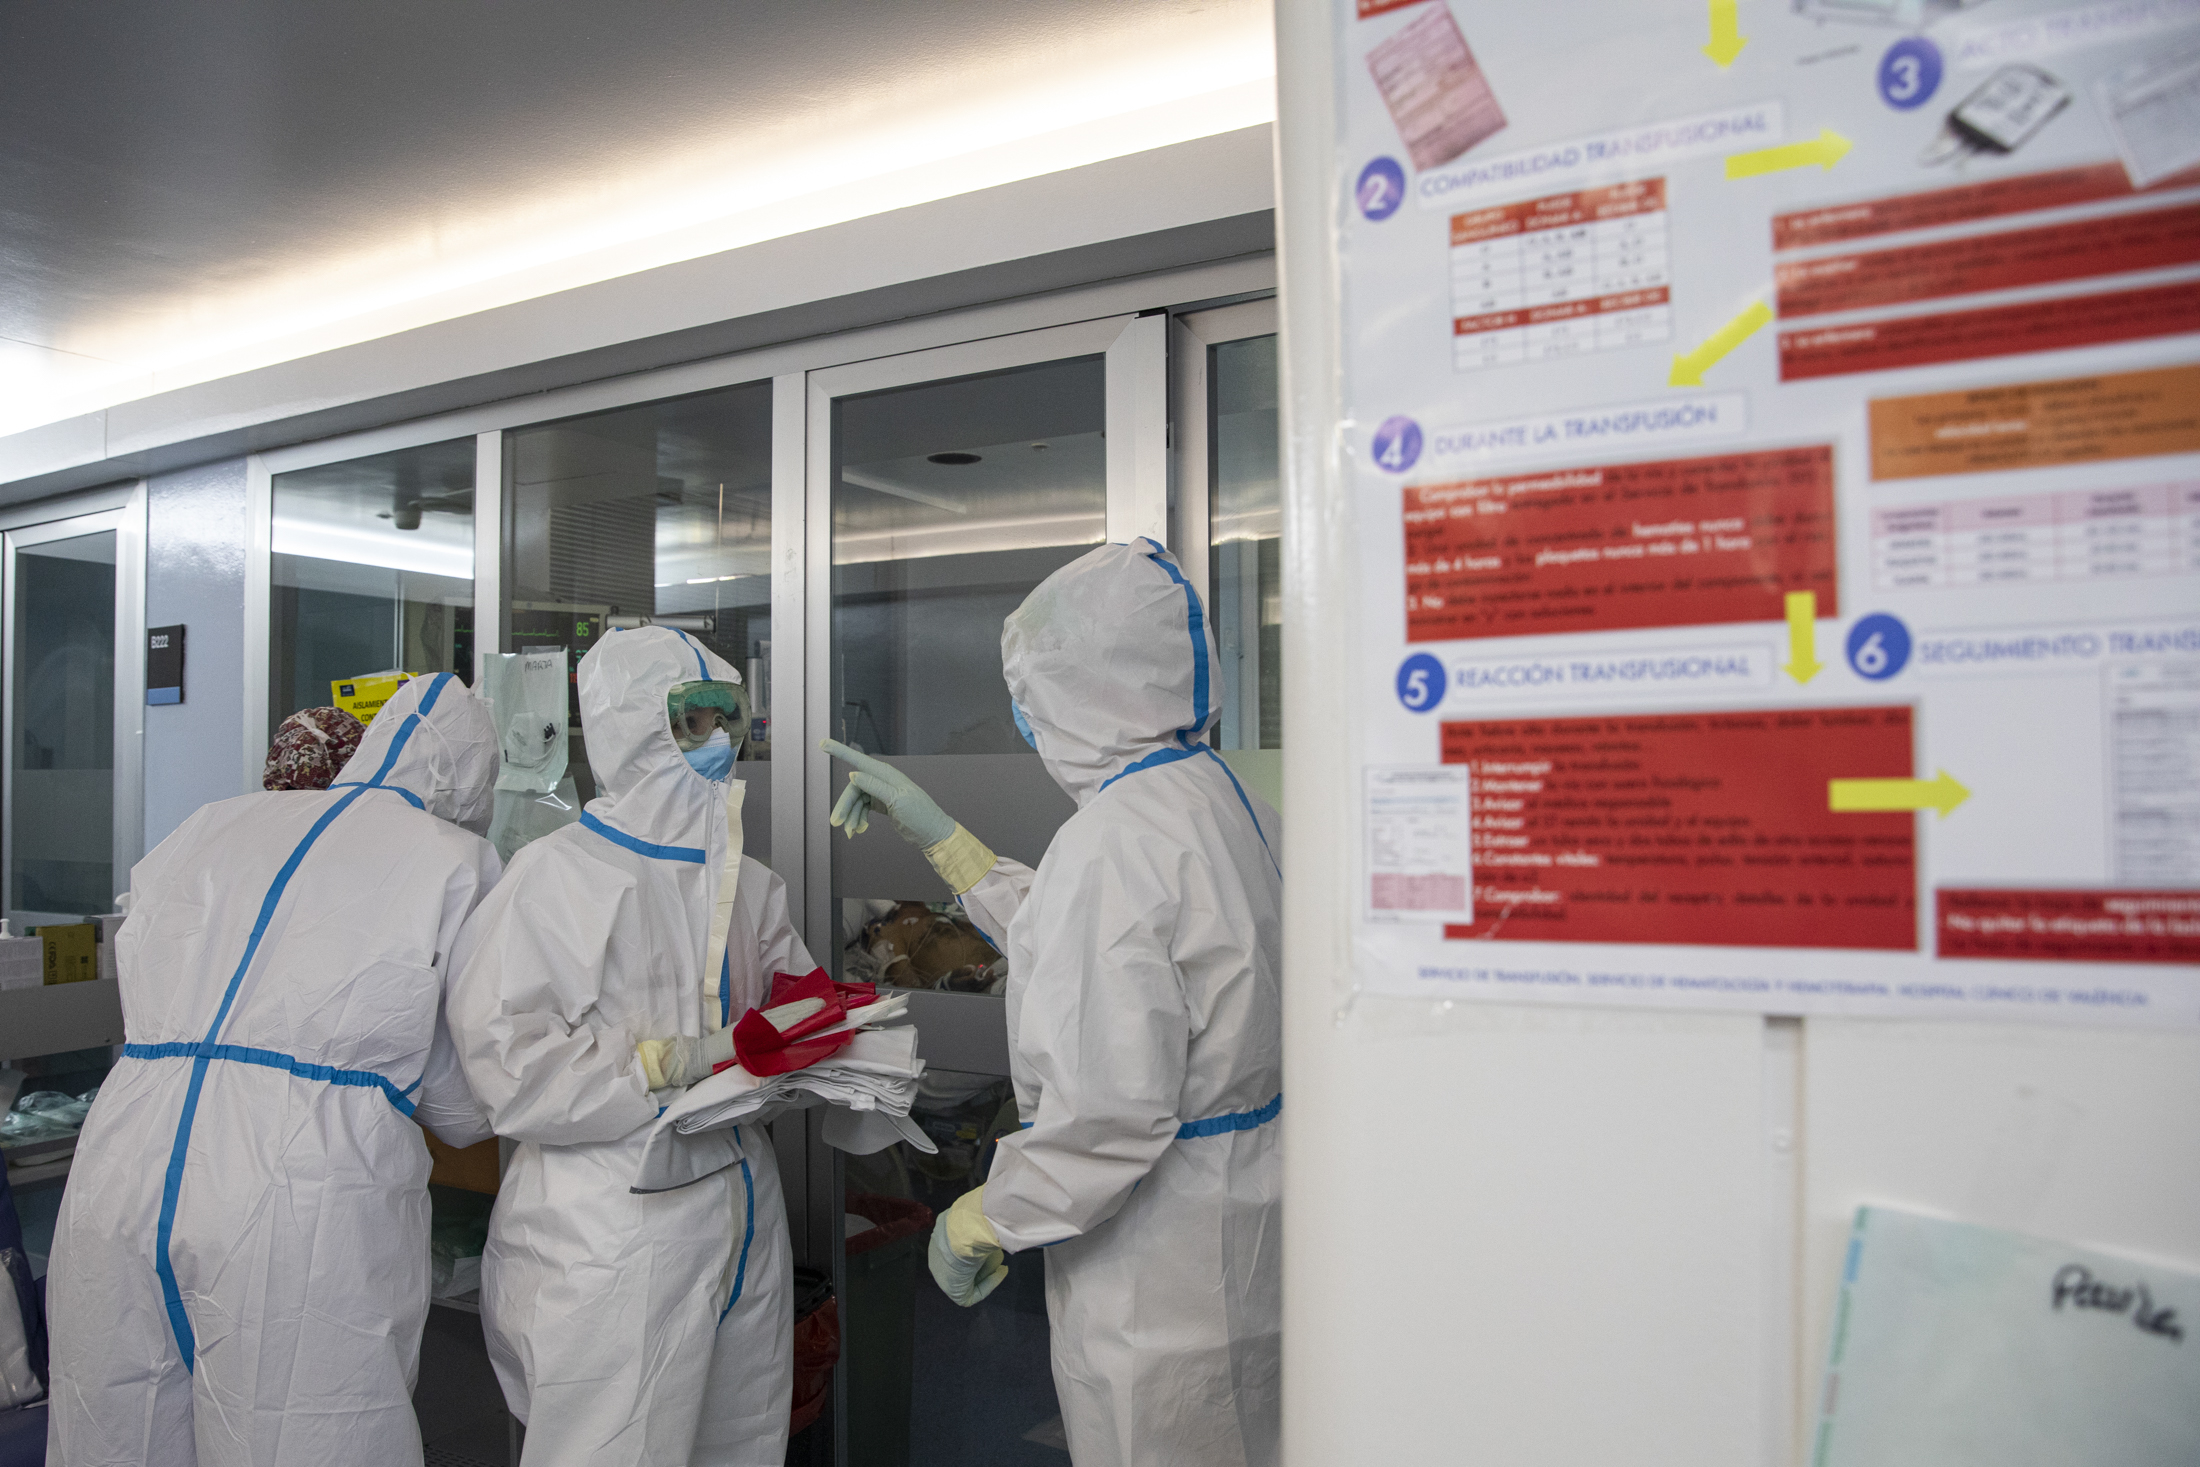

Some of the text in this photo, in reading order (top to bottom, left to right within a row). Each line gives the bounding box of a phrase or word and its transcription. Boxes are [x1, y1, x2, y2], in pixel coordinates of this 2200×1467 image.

[1889, 56, 1921, 100] 3
[1363, 174, 1389, 211] 2
[1434, 404, 1718, 454] DURANTE LA TRANSFUSIÓN
[1508, 472, 1602, 496] permeabilidad
[1465, 555, 1500, 569] horas
[1536, 546, 1599, 568] plaquetas
[1602, 545, 1643, 559] nunca
[1680, 538, 1698, 553] de
[1716, 535, 1751, 550] hora
[1422, 596, 1443, 609] No
[576, 622, 589, 637] 85
[1854, 632, 1888, 674] 6
[1920, 634, 2101, 662] SEGUIMIENTO
[1403, 668, 1429, 707] 5
[1455, 655, 1750, 689] REACCIÓN TRANSFUSIONAL
[1474, 968, 1489, 982] DE
